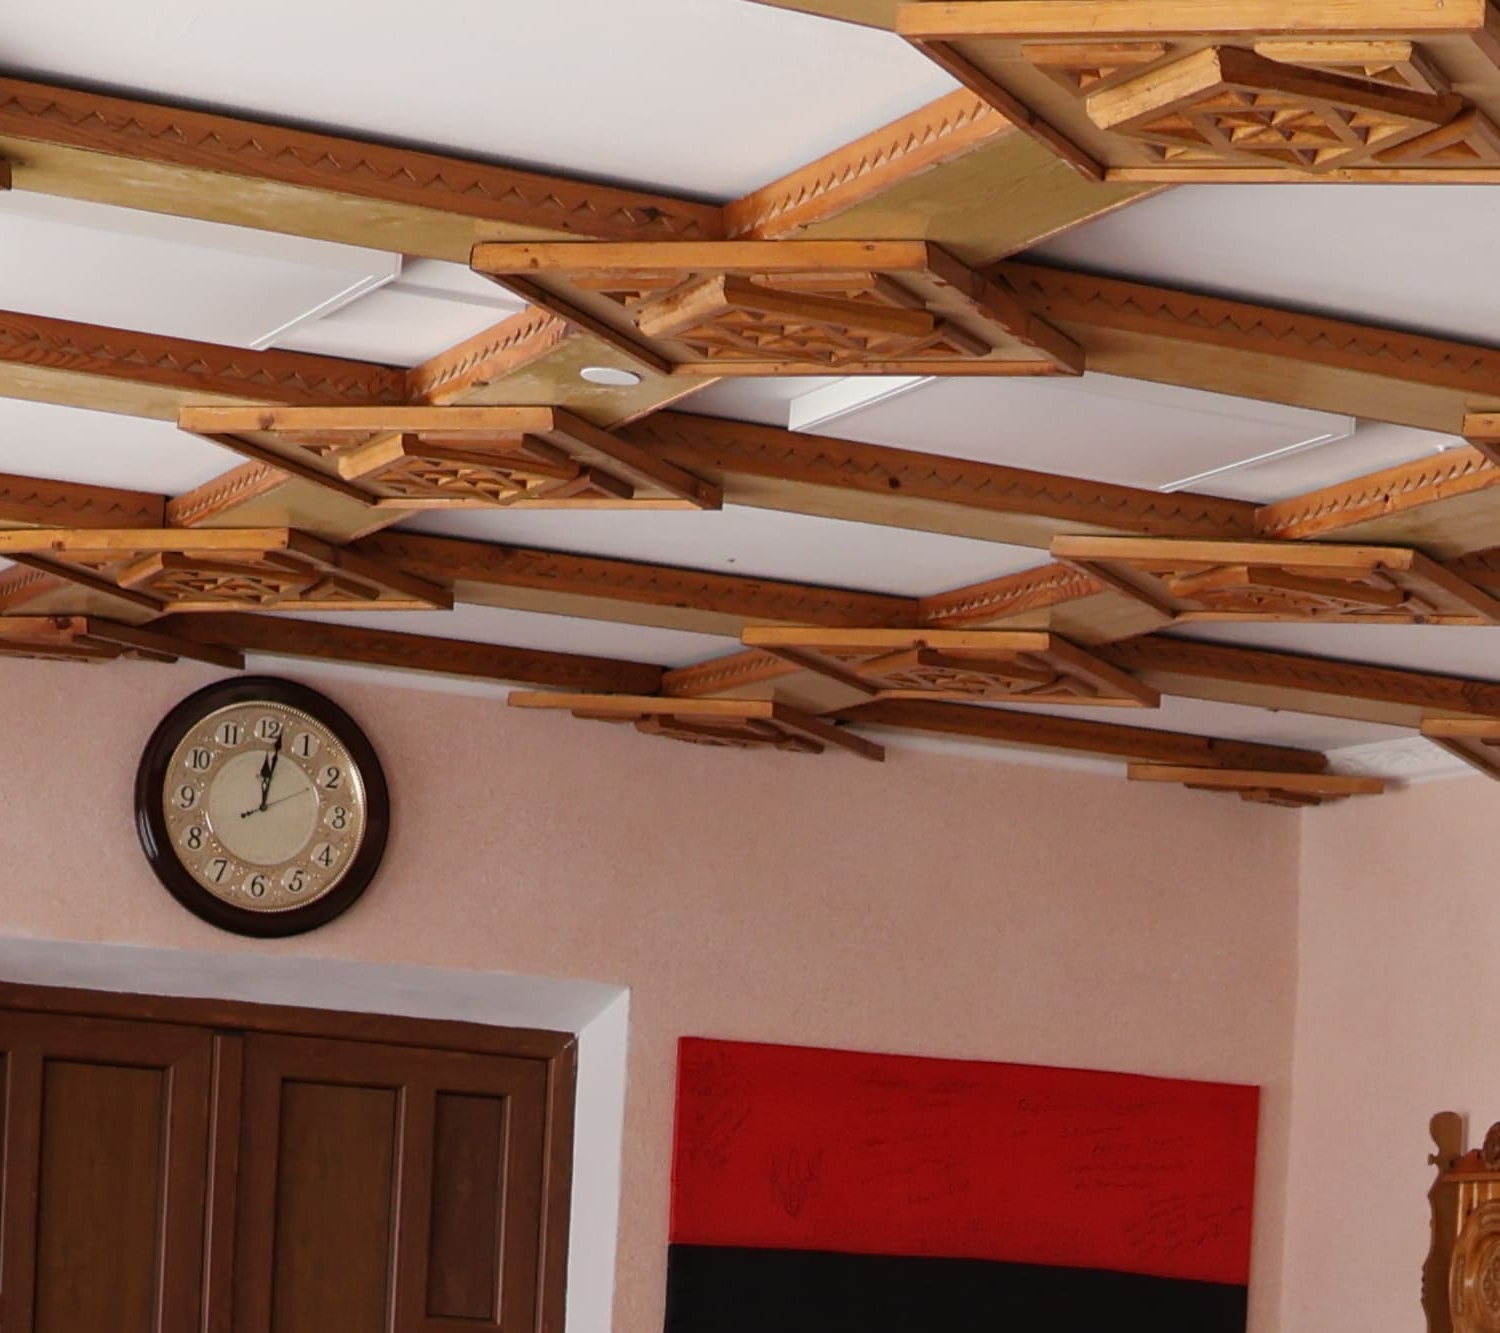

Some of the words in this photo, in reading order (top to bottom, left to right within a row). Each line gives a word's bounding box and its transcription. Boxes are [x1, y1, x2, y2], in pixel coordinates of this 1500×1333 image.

[222, 724, 240, 745] 11
[261, 719, 281, 739] 12
[302, 735, 311, 756] 1
[191, 749, 211, 770] 10
[326, 768, 340, 790] 2
[180, 785, 195, 808] 9
[333, 807, 346, 829] 3
[187, 827, 202, 850] 8
[318, 845, 333, 867] 4
[213, 859, 229, 882] 7
[290, 870, 306, 893] 5
[250, 874, 266, 898] 6
